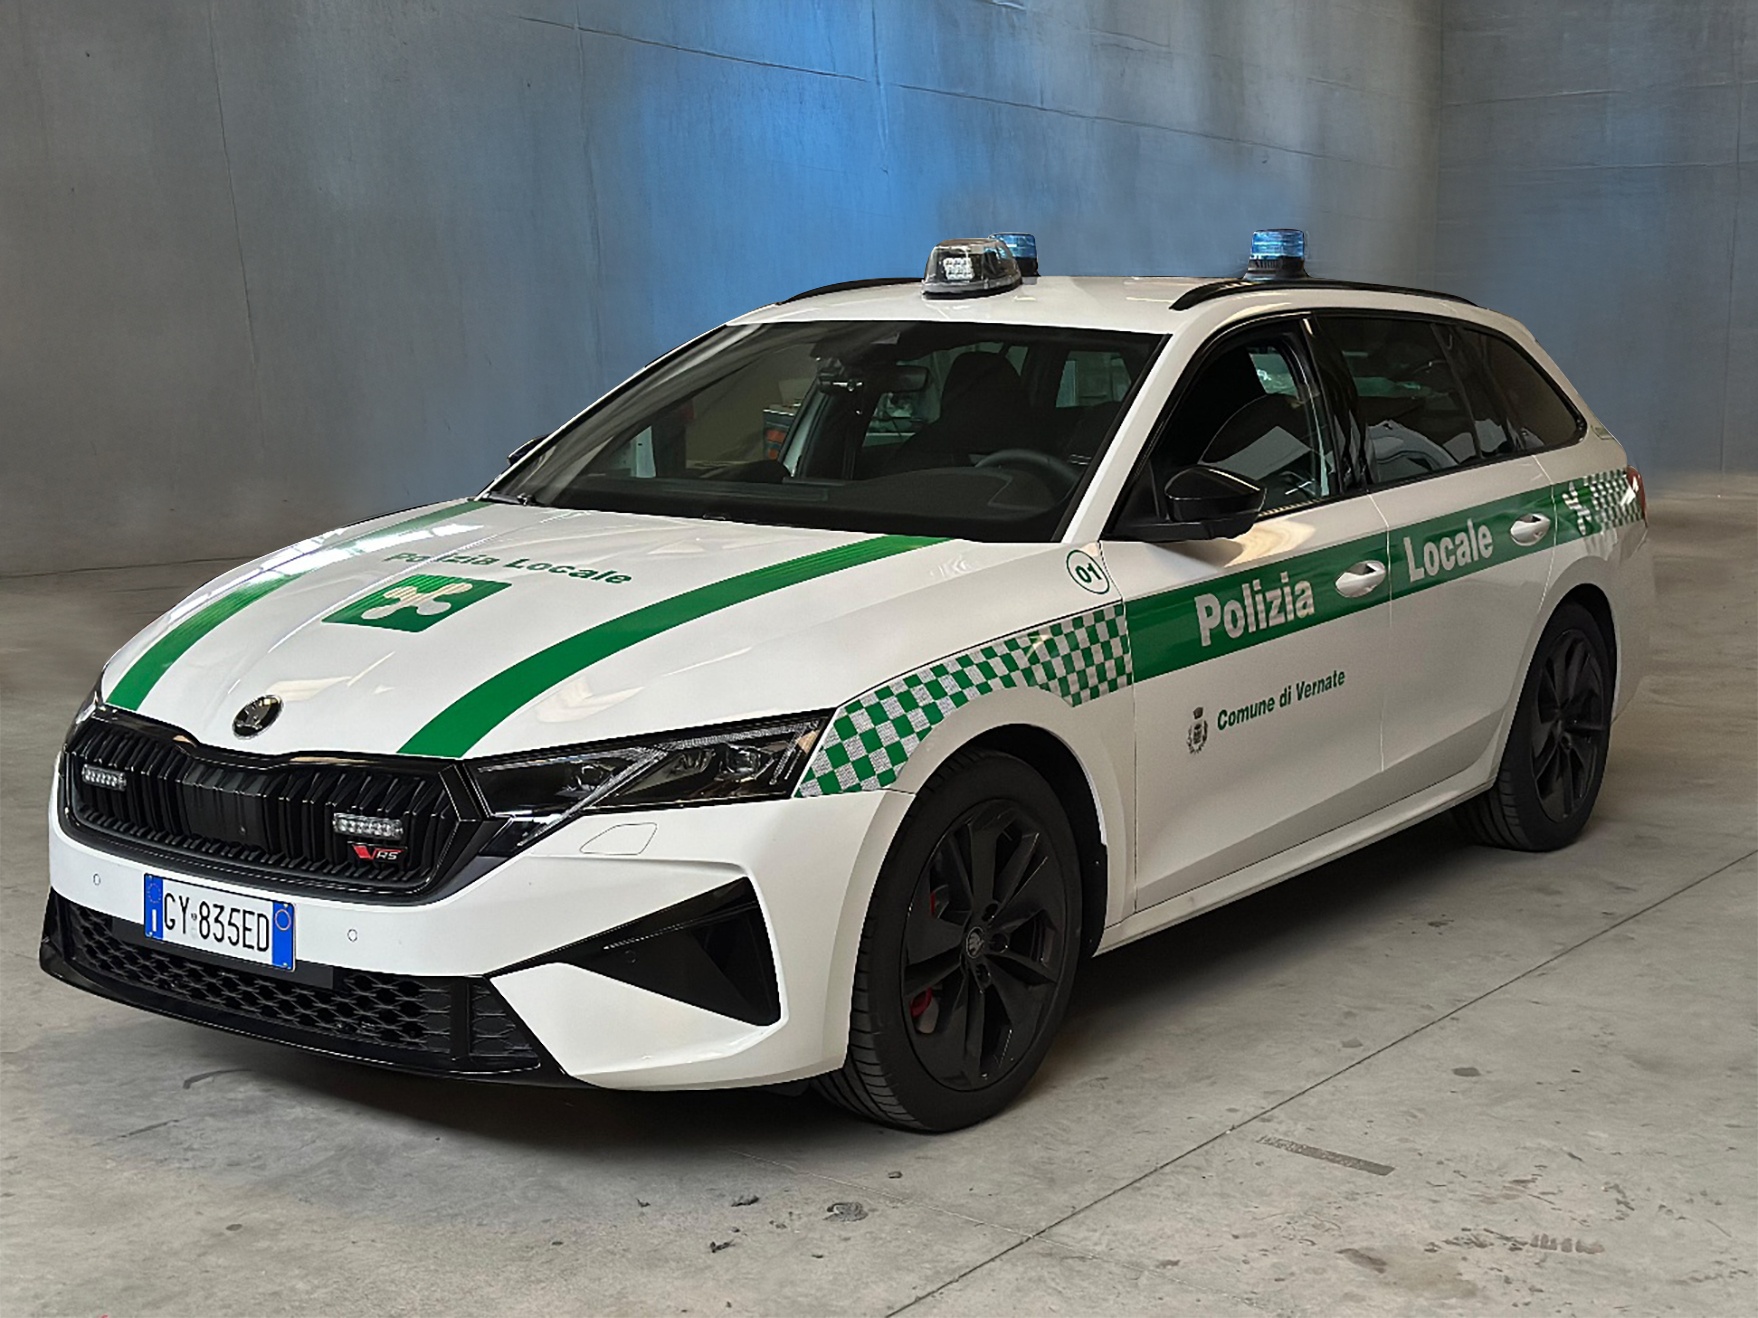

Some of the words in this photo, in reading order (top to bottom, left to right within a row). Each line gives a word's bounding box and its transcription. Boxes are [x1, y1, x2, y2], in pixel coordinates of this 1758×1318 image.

[503, 559, 632, 584] Locale
[1075, 563, 1102, 583] 01
[1194, 571, 1315, 646] Polizia
[1403, 518, 1493, 582] Locale
[1217, 697, 1275, 731] Comune
[1279, 685, 1292, 707] di
[1296, 670, 1346, 701] Vernate
